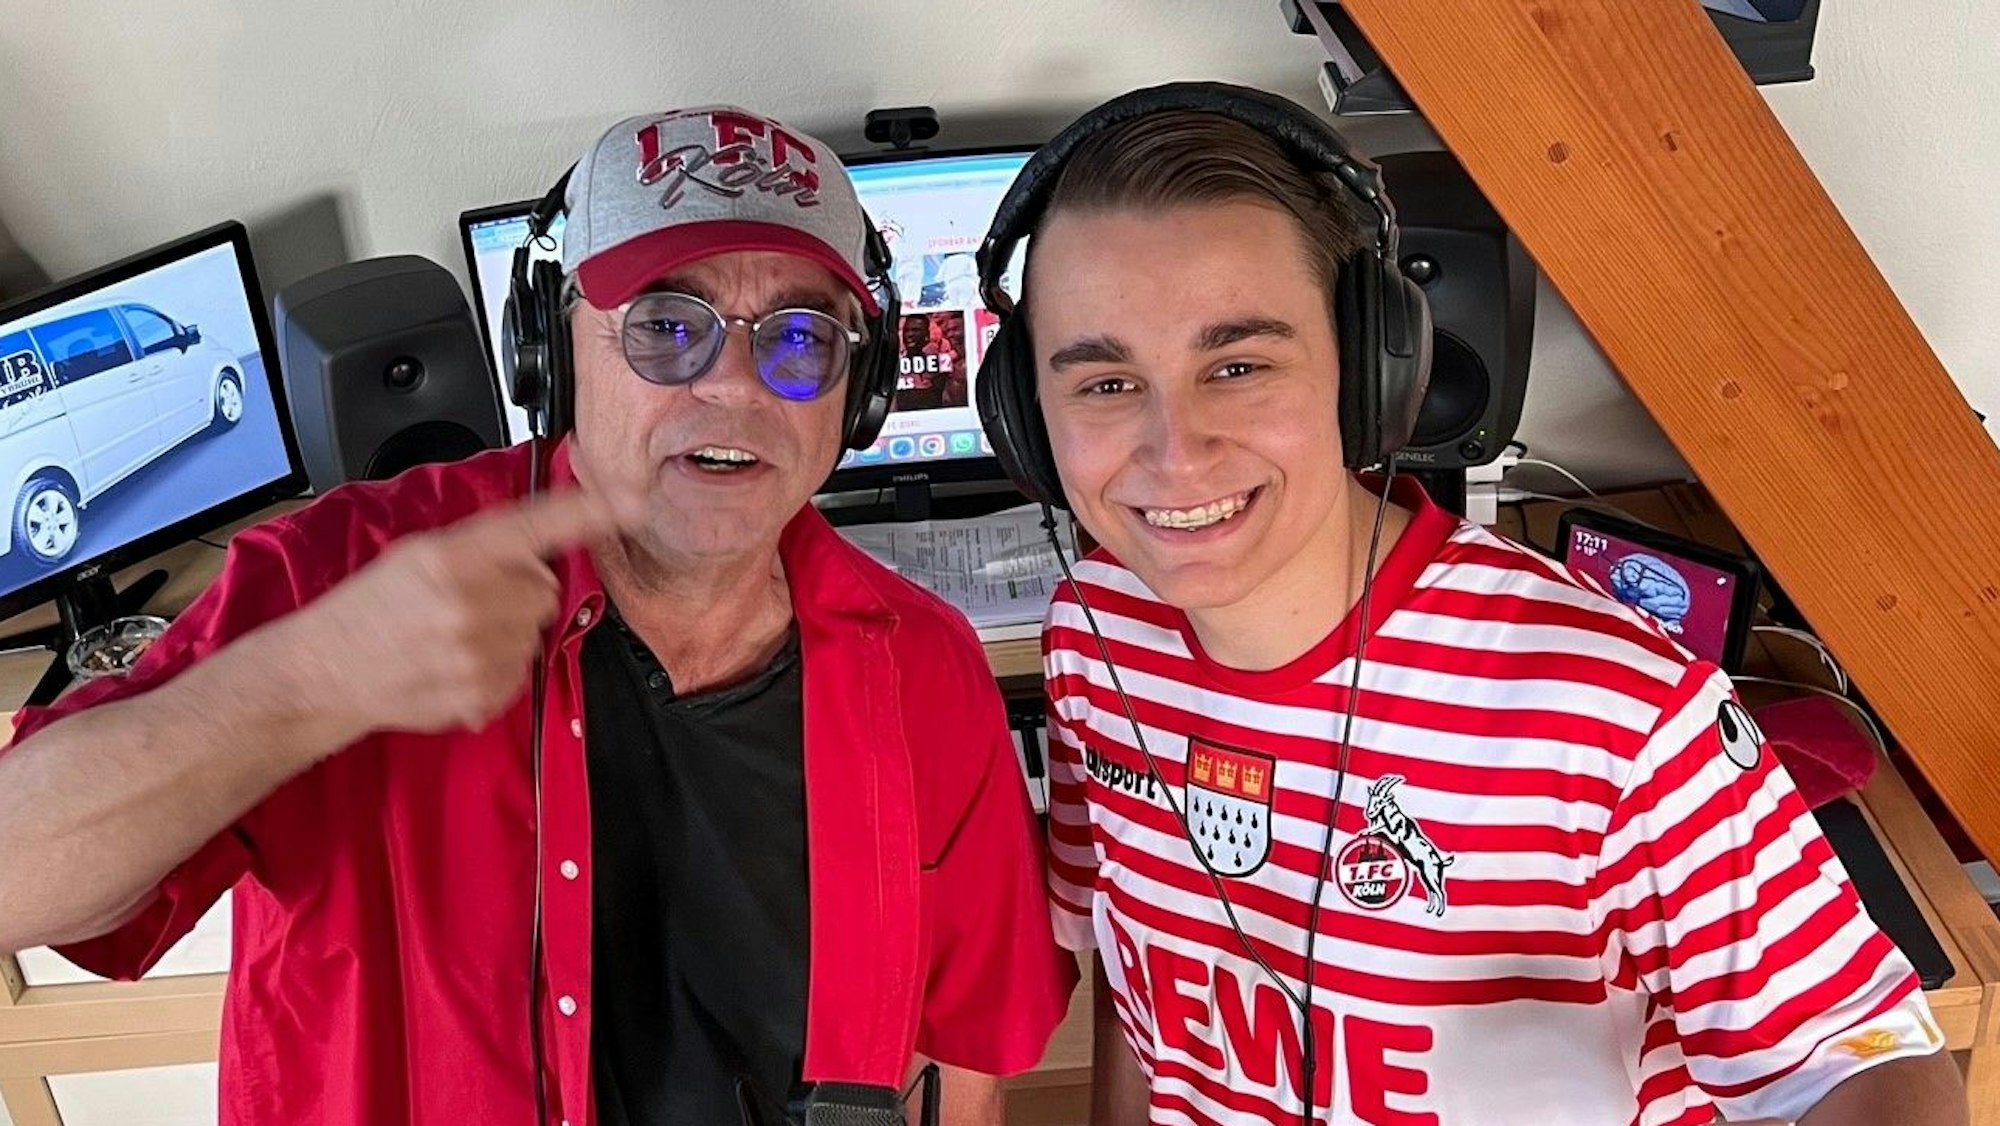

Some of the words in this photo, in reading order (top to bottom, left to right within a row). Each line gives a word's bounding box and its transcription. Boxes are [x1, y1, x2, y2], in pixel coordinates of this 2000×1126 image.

[709, 112, 820, 194] FC
[640, 144, 821, 210] Köln
[892, 473, 929, 482] PHILIPS
[1576, 531, 1608, 551] 17:11
[1350, 866, 1365, 880] 1.
[1367, 863, 1393, 879] FC
[1352, 882, 1387, 898] KÖLN
[1107, 907, 1440, 1126] REWE
